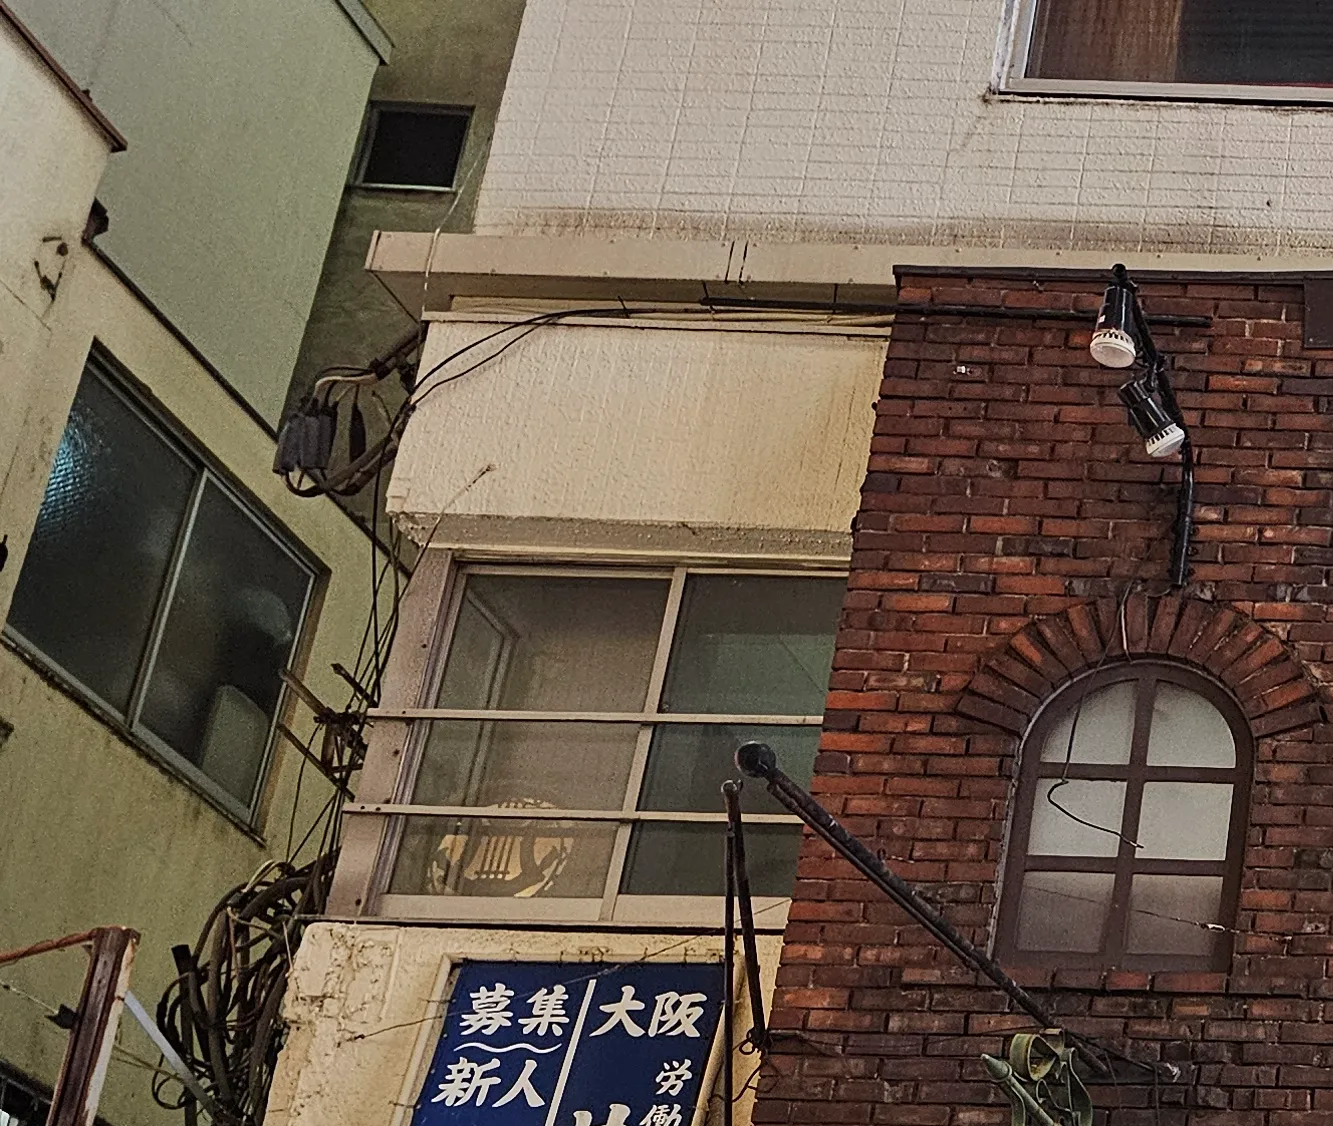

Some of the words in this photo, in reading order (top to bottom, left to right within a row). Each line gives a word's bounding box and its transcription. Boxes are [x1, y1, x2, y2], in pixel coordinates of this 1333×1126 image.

[457, 983, 571, 1038] 募集
[590, 984, 709, 1039] 大阪
[430, 1056, 546, 1109] 新人
